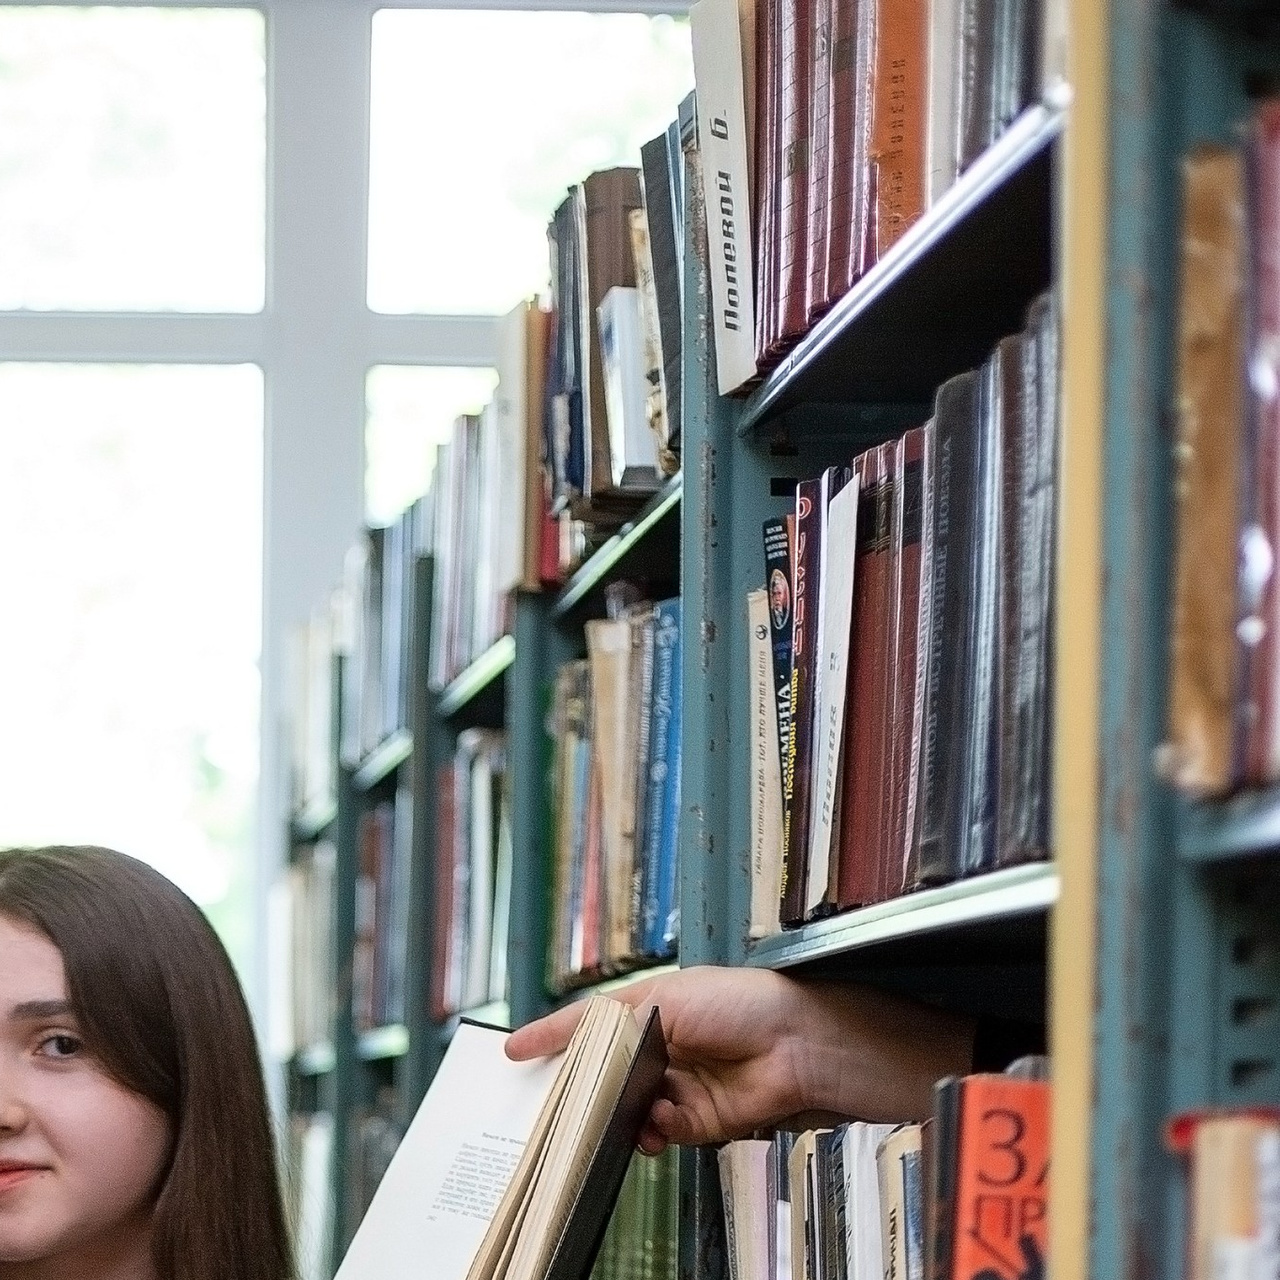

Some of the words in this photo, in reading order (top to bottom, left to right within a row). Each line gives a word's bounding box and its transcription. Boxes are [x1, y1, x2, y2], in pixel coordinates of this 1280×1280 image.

[715, 169, 741, 332] Полевой
[755, 679, 767, 716] ЛУЧШЕ
[756, 716, 767, 738] КТО
